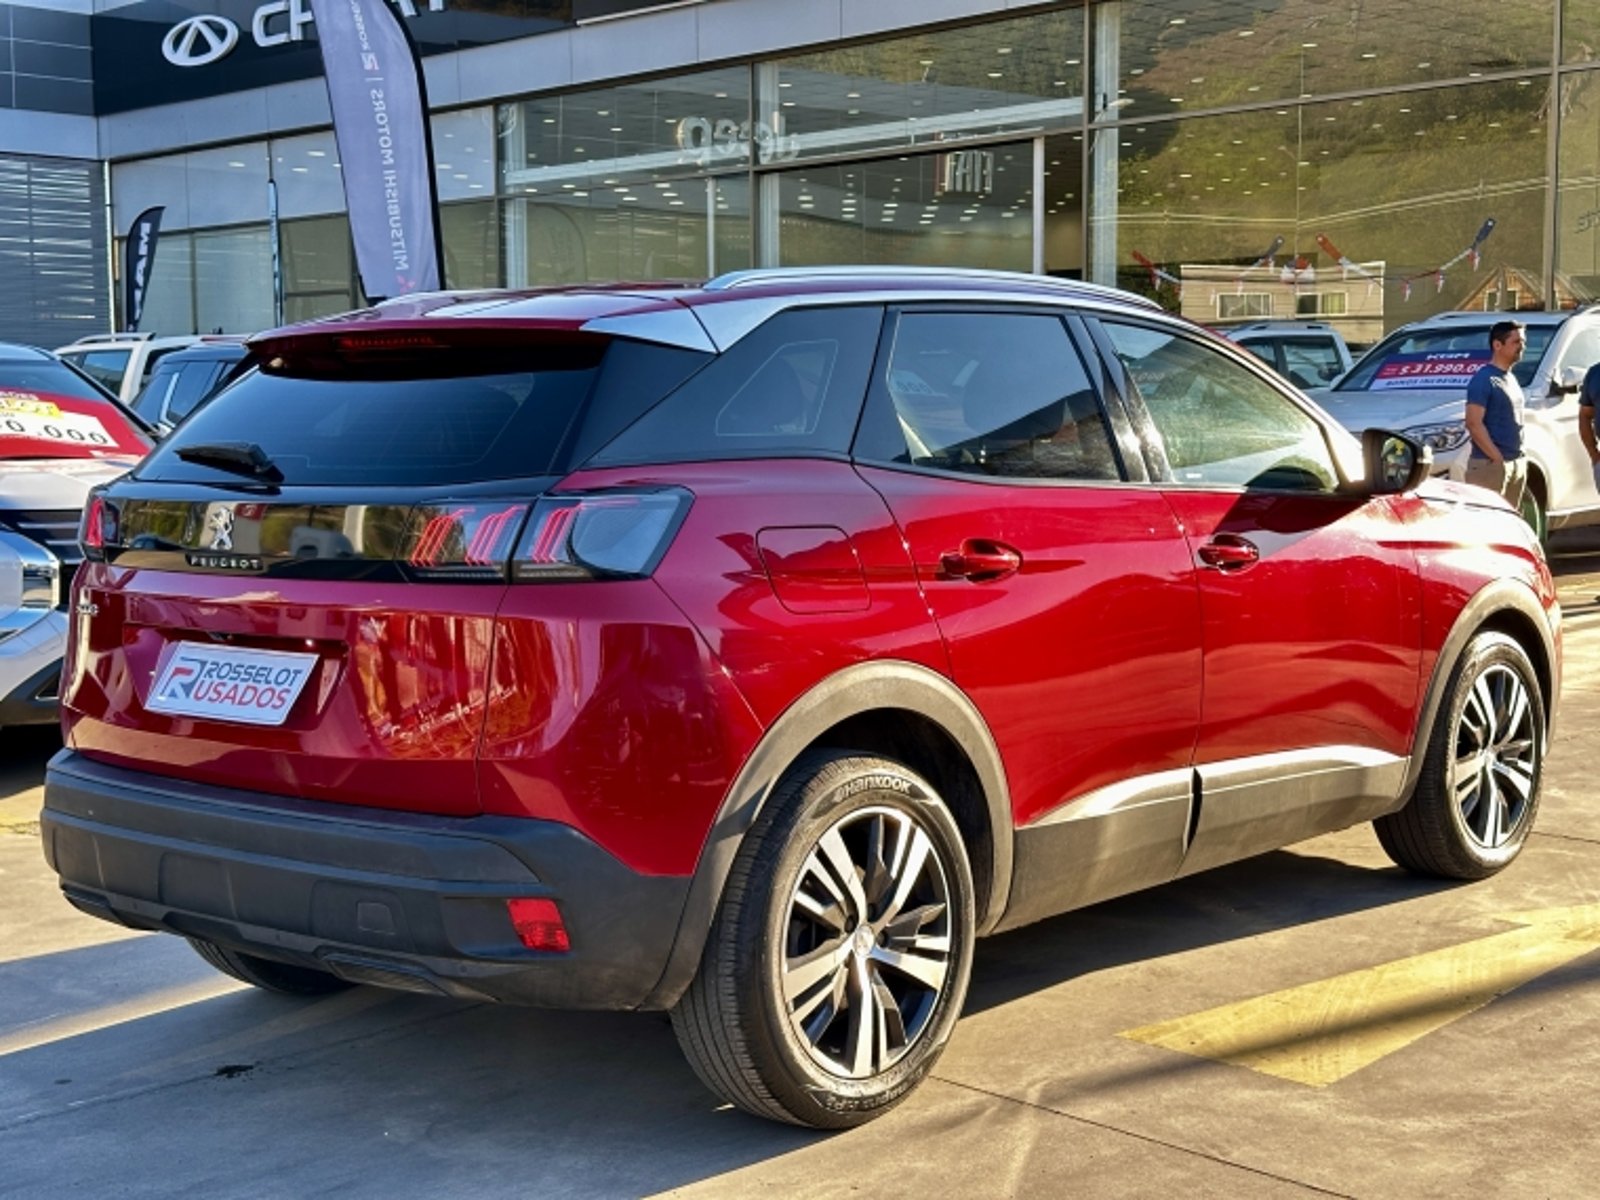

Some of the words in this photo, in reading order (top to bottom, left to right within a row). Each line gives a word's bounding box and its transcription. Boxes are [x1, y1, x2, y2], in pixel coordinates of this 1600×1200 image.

[190, 555, 260, 570] PEUGEOT
[203, 661, 302, 688] ROSSELOT
[192, 679, 292, 710] USADOS
